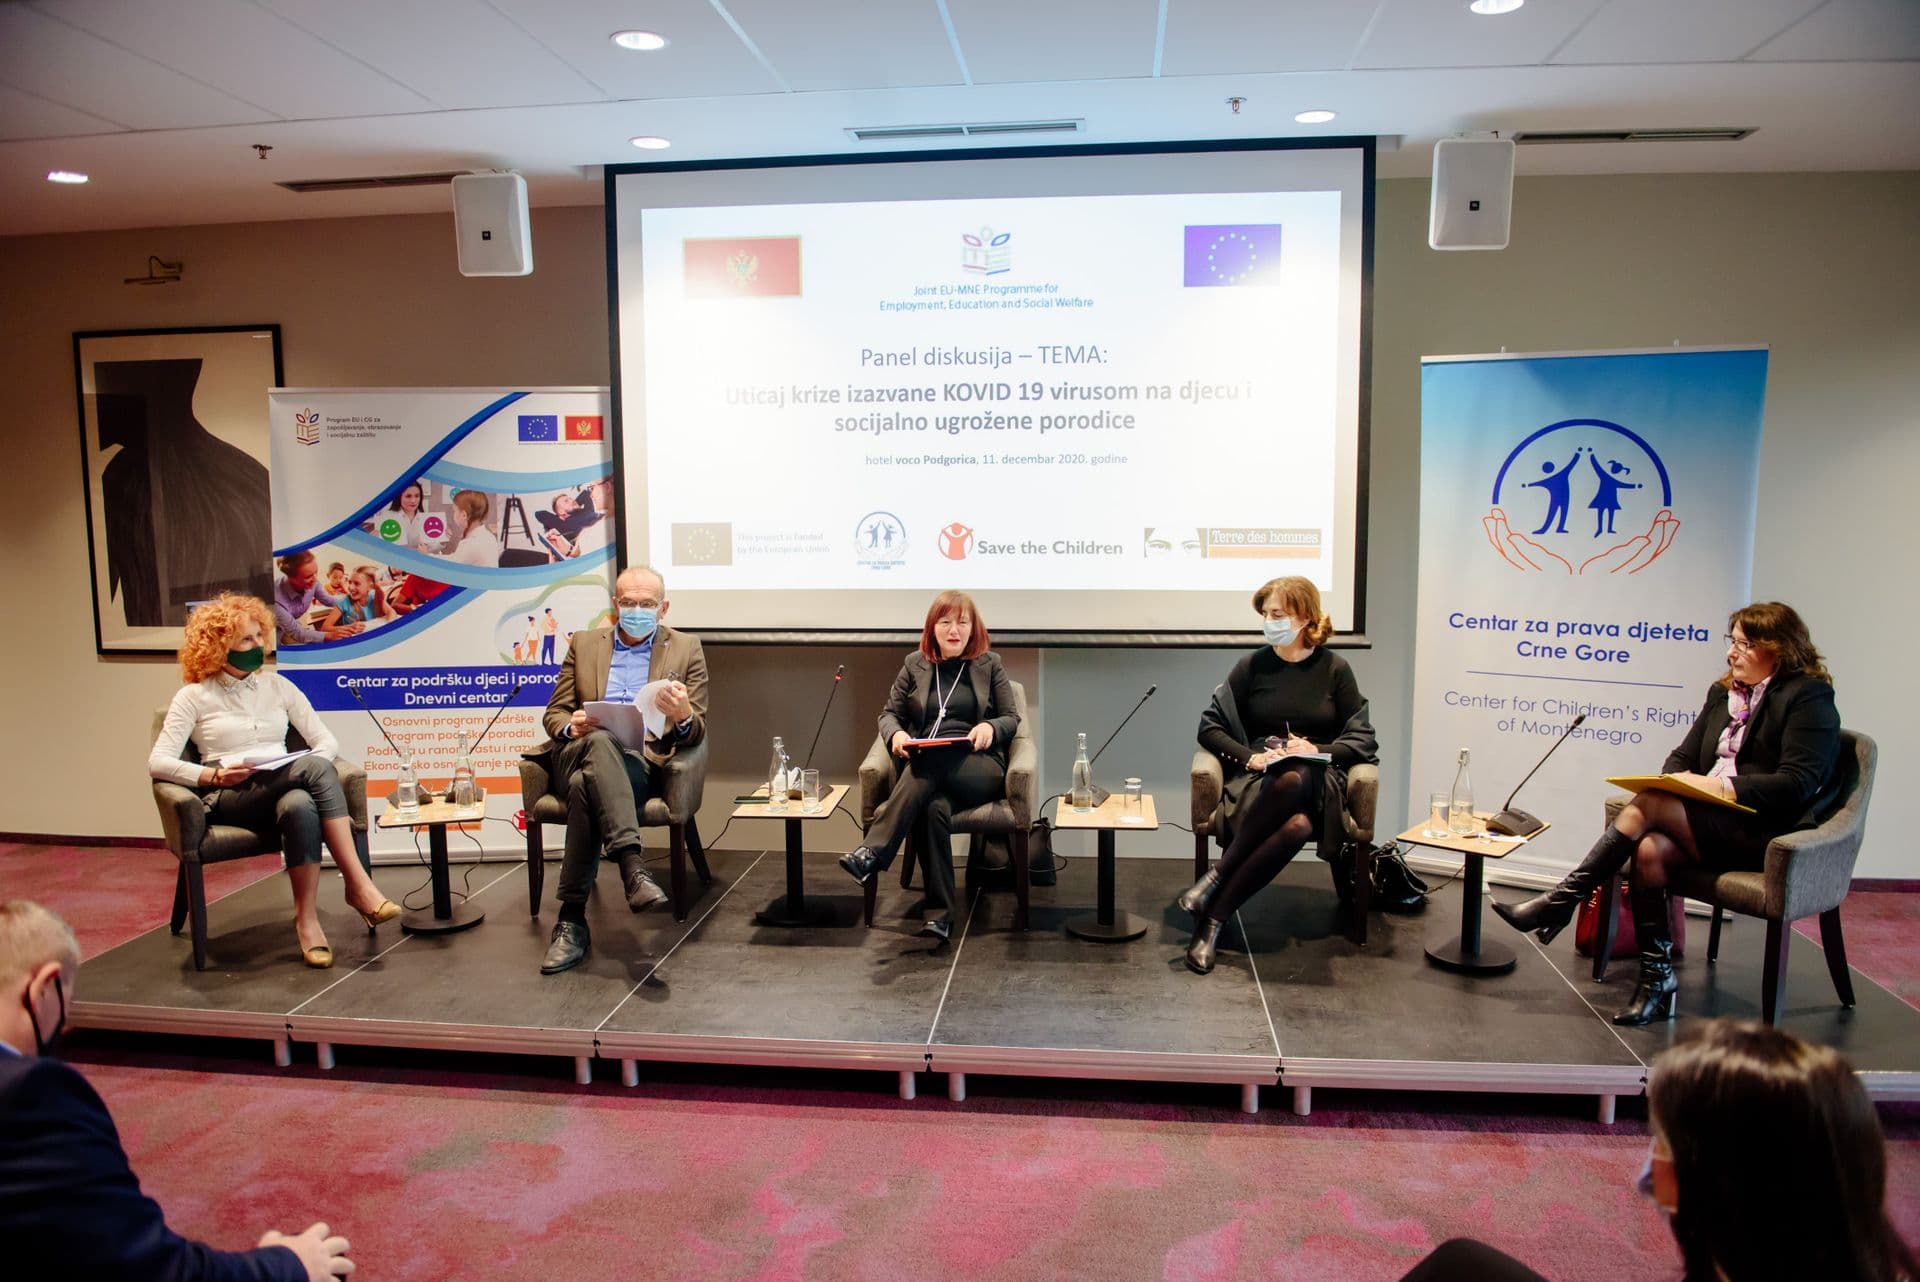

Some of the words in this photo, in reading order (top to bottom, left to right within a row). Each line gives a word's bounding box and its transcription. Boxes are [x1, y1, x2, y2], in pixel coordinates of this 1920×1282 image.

[914, 285, 937, 296] Joint
[940, 284, 980, 295] EU-MNE
[984, 284, 1043, 298] Programme
[1043, 283, 1059, 294] for
[880, 300, 947, 312] Employment,
[949, 299, 1000, 310] Education
[1001, 298, 1021, 309] and
[1023, 298, 1053, 309] Social
[1056, 297, 1094, 308] Welfare
[861, 347, 916, 367] Panel
[923, 346, 1012, 368] diskusija
[1037, 345, 1108, 364] TEMA:
[726, 385, 785, 408] Uticaj
[792, 384, 841, 404] krize
[848, 384, 936, 403] izazvane
[944, 383, 1011, 402] KOVID
[1018, 382, 1044, 401] 19
[1050, 381, 1138, 401] virusom
[1145, 384, 1172, 400] na
[1179, 380, 1239, 404] djecu
[834, 412, 928, 436] socijalno
[935, 411, 1033, 435] ugrožene
[1040, 410, 1136, 434] porodice
[865, 455, 893, 465] hotel
[895, 457, 921, 465] voco
[923, 454, 978, 467] Podgorica,
[982, 454, 999, 465] 11.
[1001, 454, 1054, 465] decembar
[1058, 454, 1088, 465] 2020.
[1091, 454, 1128, 467] godine
[1212, 530, 1244, 543] Terre
[1247, 530, 1265, 543] des
[1270, 530, 1318, 543] hommes
[978, 540, 1017, 555] Save
[1021, 541, 1047, 555] the
[1052, 540, 1123, 555] Children
[1449, 612, 1518, 632] Centar
[1525, 619, 1548, 633] za
[1556, 621, 1620, 638] prava
[1628, 621, 1709, 642] djeteta
[1516, 641, 1567, 659] Crne
[1575, 644, 1630, 663] Gore
[336, 675, 388, 688] Centar
[391, 677, 408, 686] za
[411, 673, 472, 689] podršku
[475, 672, 508, 689] djeci
[404, 692, 456, 704] Dnevni
[459, 692, 508, 703] centar
[1444, 690, 1507, 710] Center
[1512, 696, 1537, 712] for
[1542, 698, 1639, 721] Children's
[1646, 707, 1698, 728] Right
[382, 716, 431, 726] Osnovni
[433, 716, 484, 728] program
[487, 714, 534, 725] podrške
[384, 732, 434, 744] Program
[488, 728, 535, 741] porodici
[1497, 718, 1516, 732] of
[1521, 720, 1643, 745] Montenegro
[364, 760, 431, 771] Ekonosko
